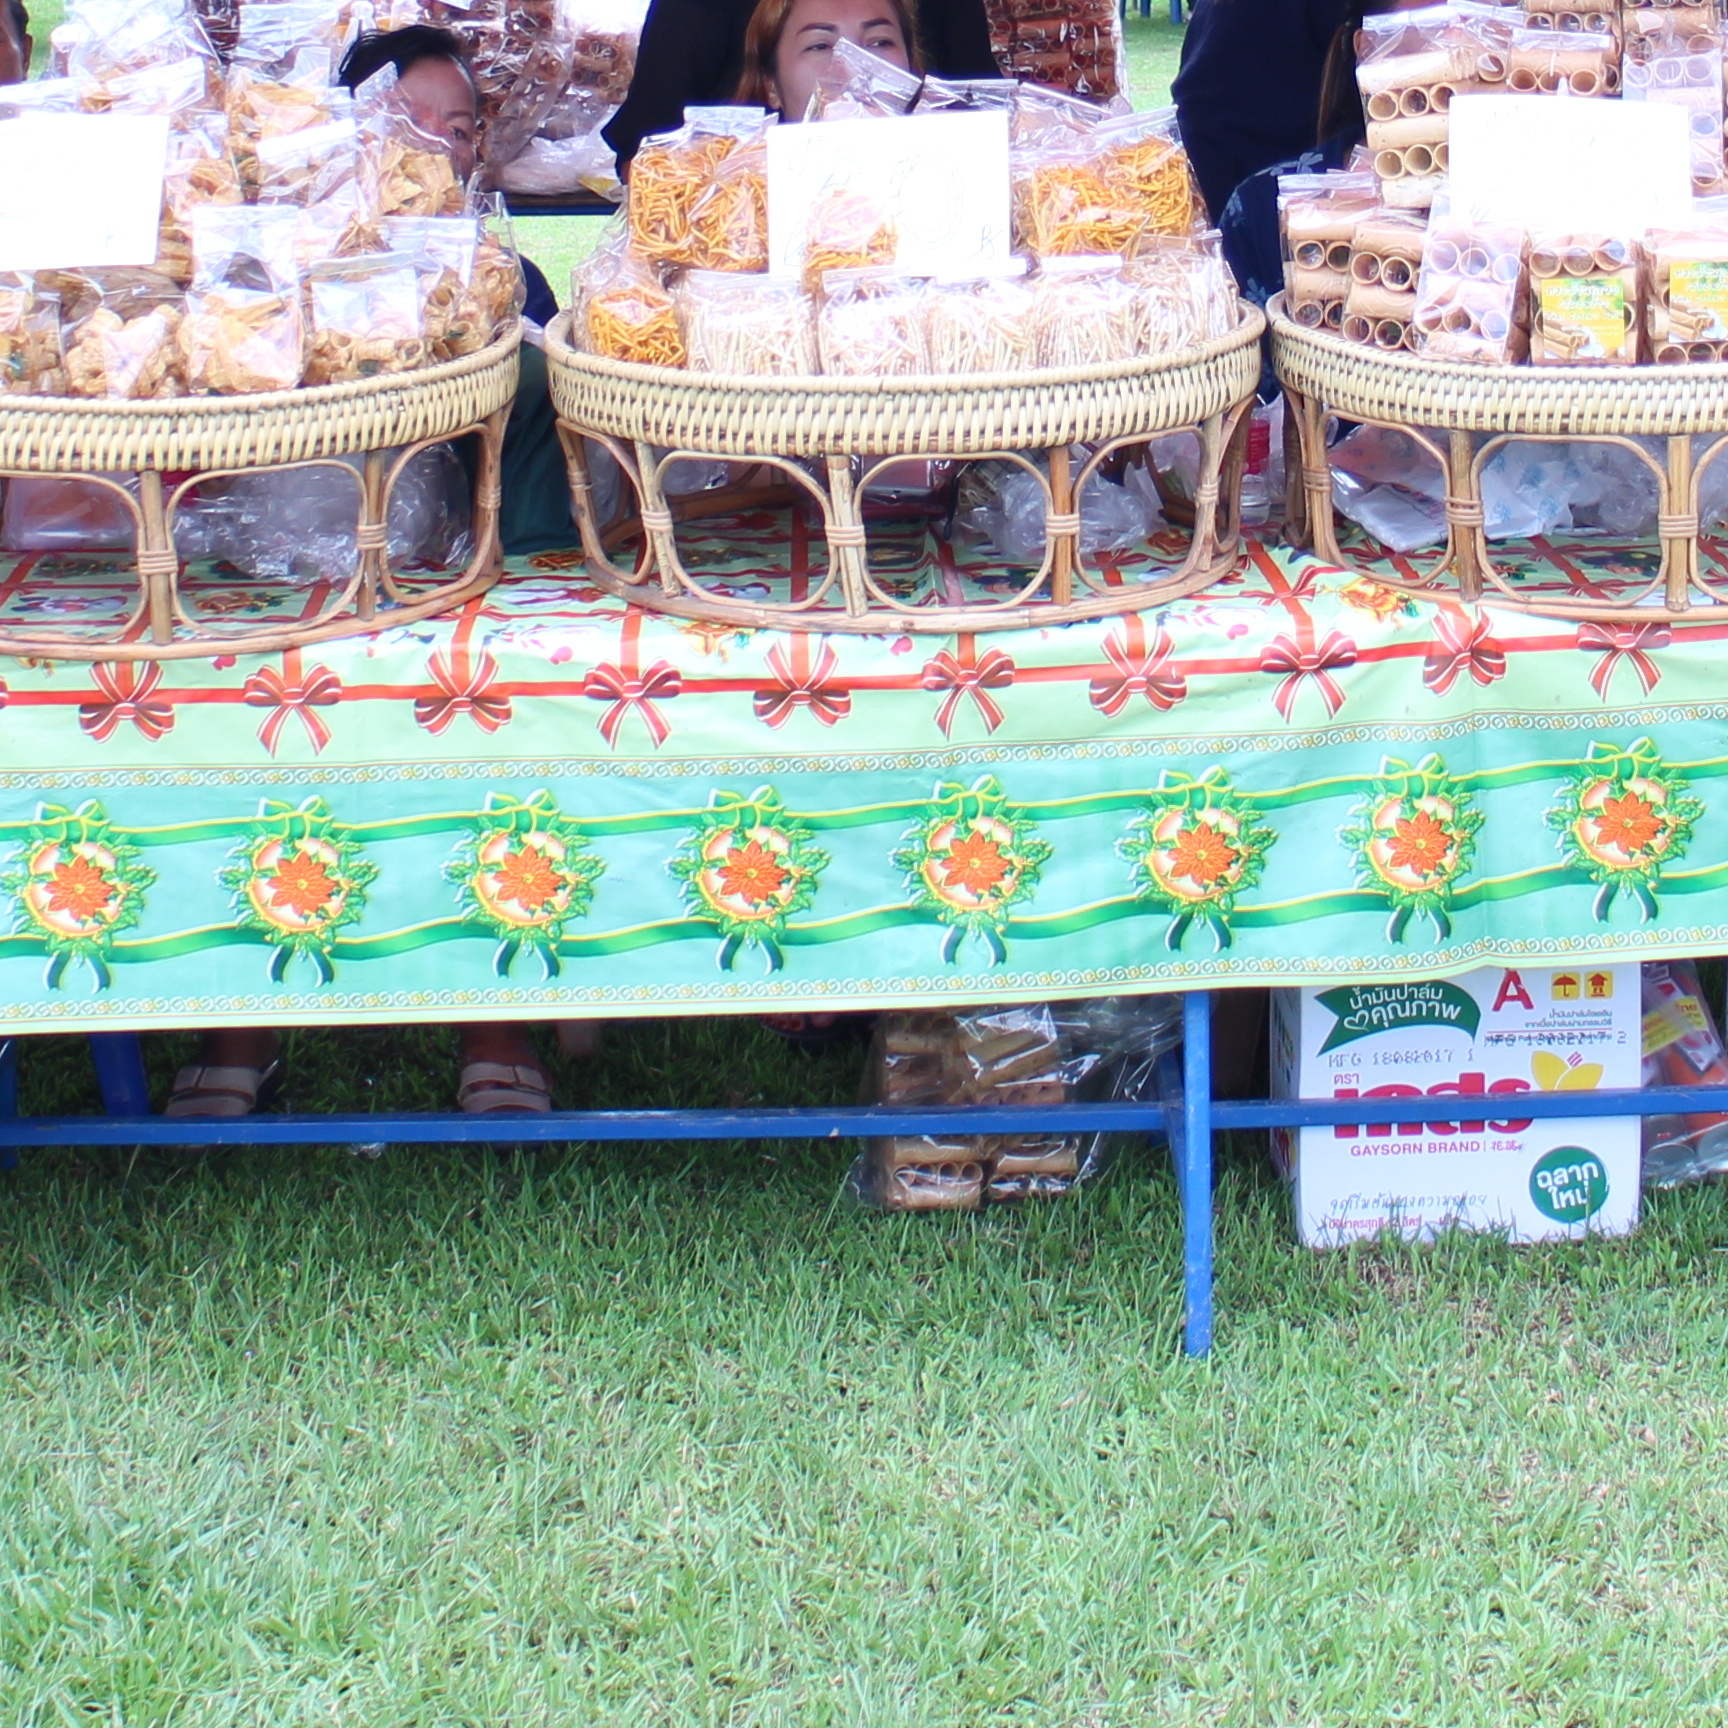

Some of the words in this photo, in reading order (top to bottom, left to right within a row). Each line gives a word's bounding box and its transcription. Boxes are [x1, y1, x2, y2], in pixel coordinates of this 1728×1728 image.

[1349, 983, 1443, 1010] น้ำมันปาล์ม
[1371, 1000, 1462, 1028] คุณภาพ
[1333, 1073, 1360, 1085] ตรา
[1350, 1141, 1423, 1157] GAYSORN
[1427, 1140, 1480, 1154] BRAND
